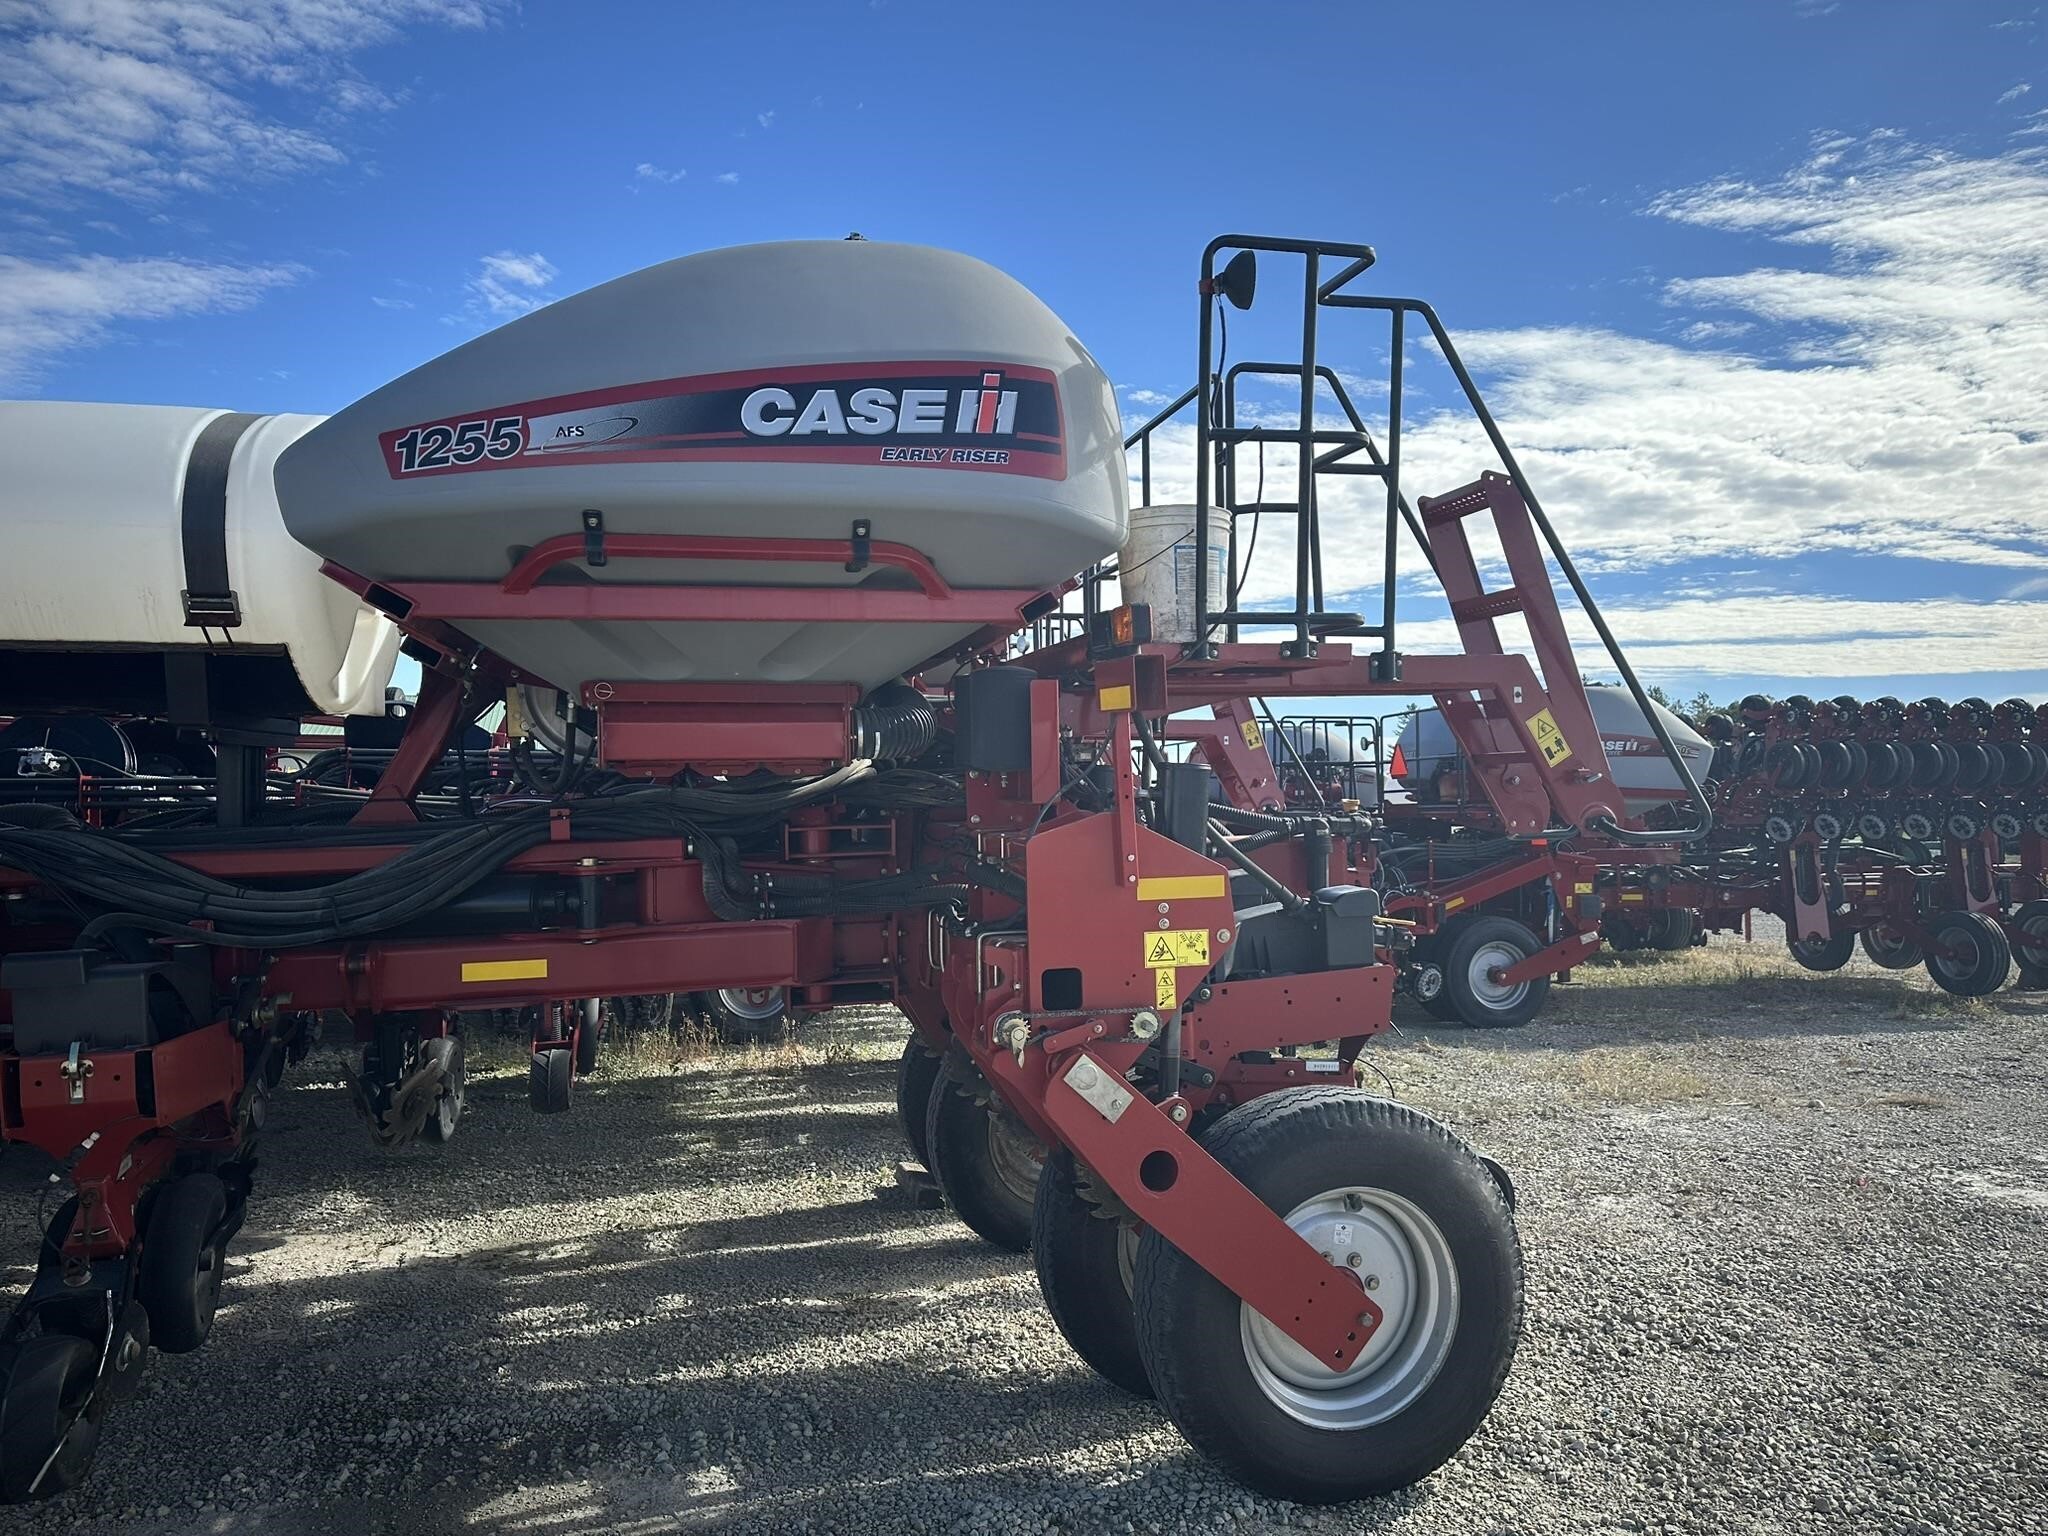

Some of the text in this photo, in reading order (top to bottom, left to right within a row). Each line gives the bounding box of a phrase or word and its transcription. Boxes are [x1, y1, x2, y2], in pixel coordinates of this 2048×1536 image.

[741, 387, 949, 437] CASE
[395, 416, 523, 472] 1255
[555, 425, 585, 438] AFS
[880, 448, 1009, 464] EARLY RISER
